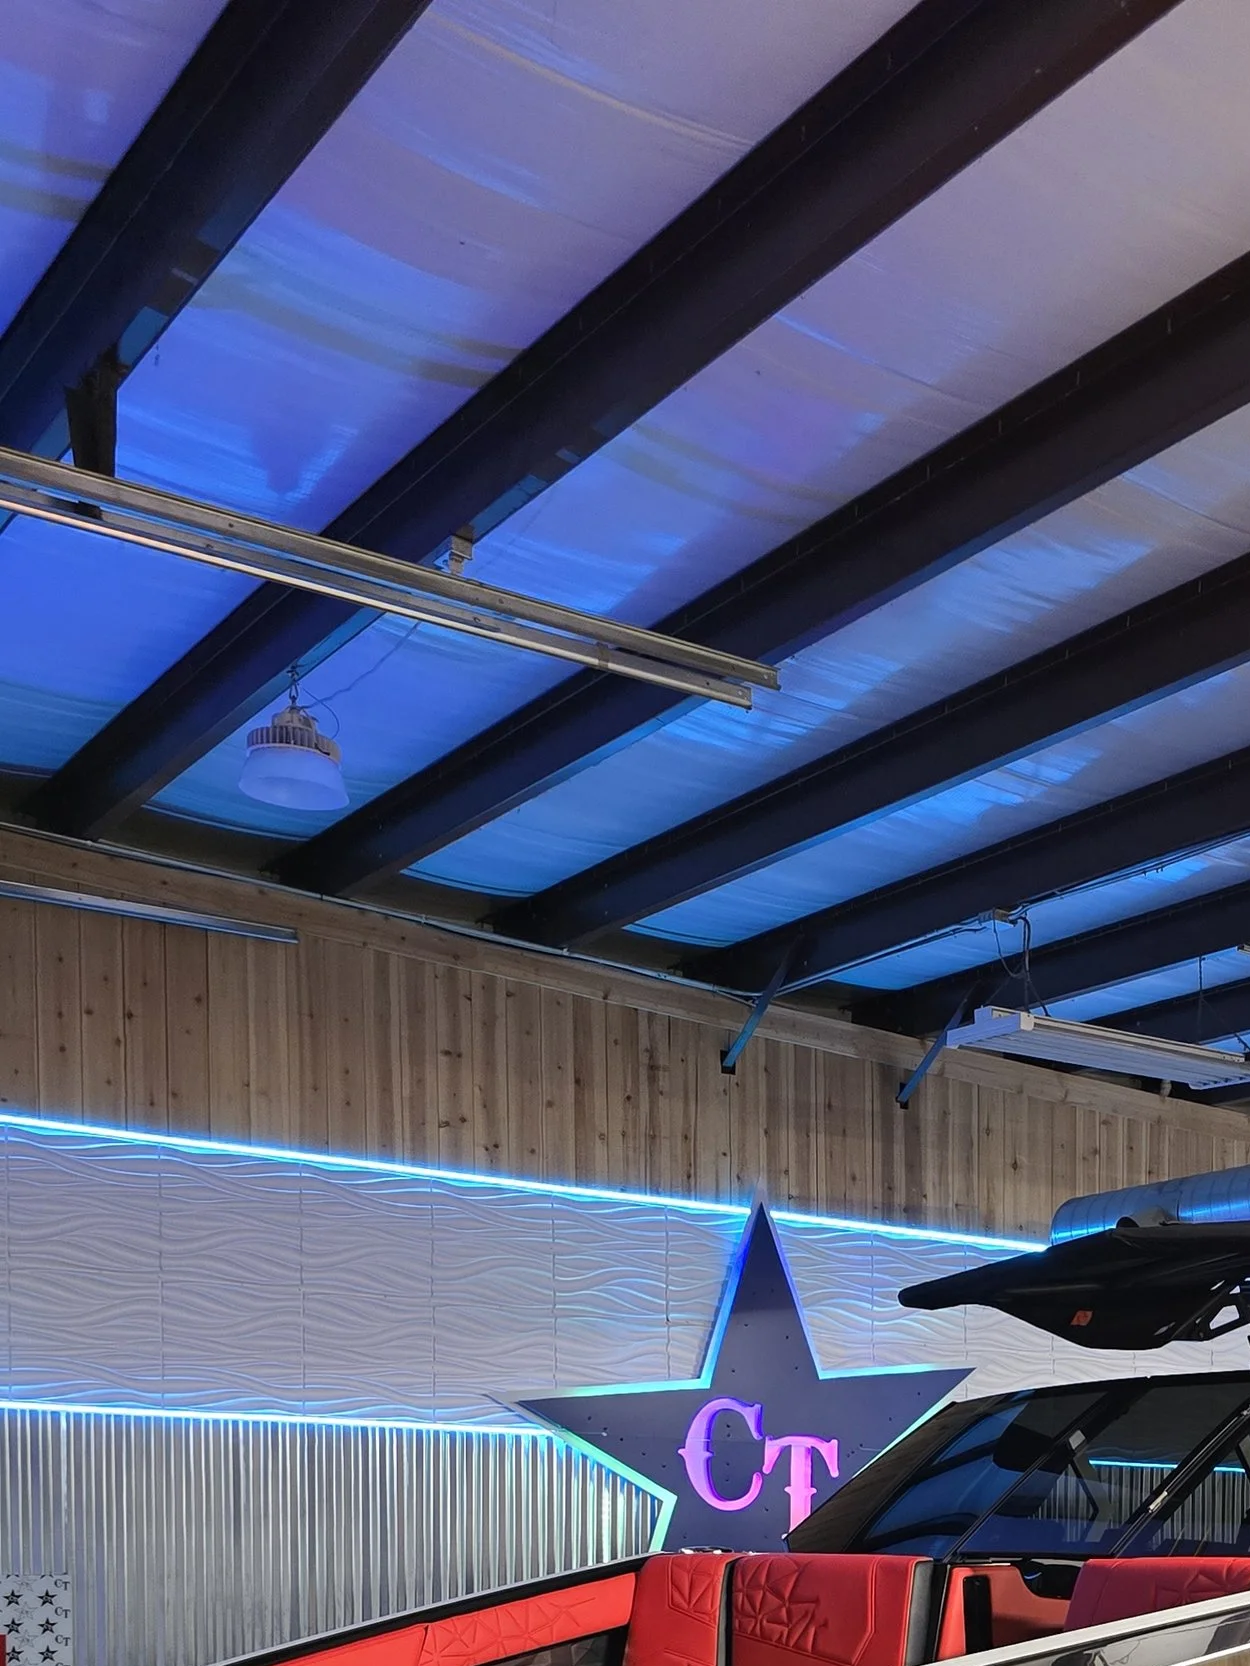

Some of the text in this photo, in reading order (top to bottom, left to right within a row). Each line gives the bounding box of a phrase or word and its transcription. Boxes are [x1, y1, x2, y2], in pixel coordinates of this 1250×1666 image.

[677, 1396, 839, 1538] CT
[54, 1578, 71, 1591] CT
[54, 1606, 71, 1619] CT
[55, 1634, 71, 1647] CT
